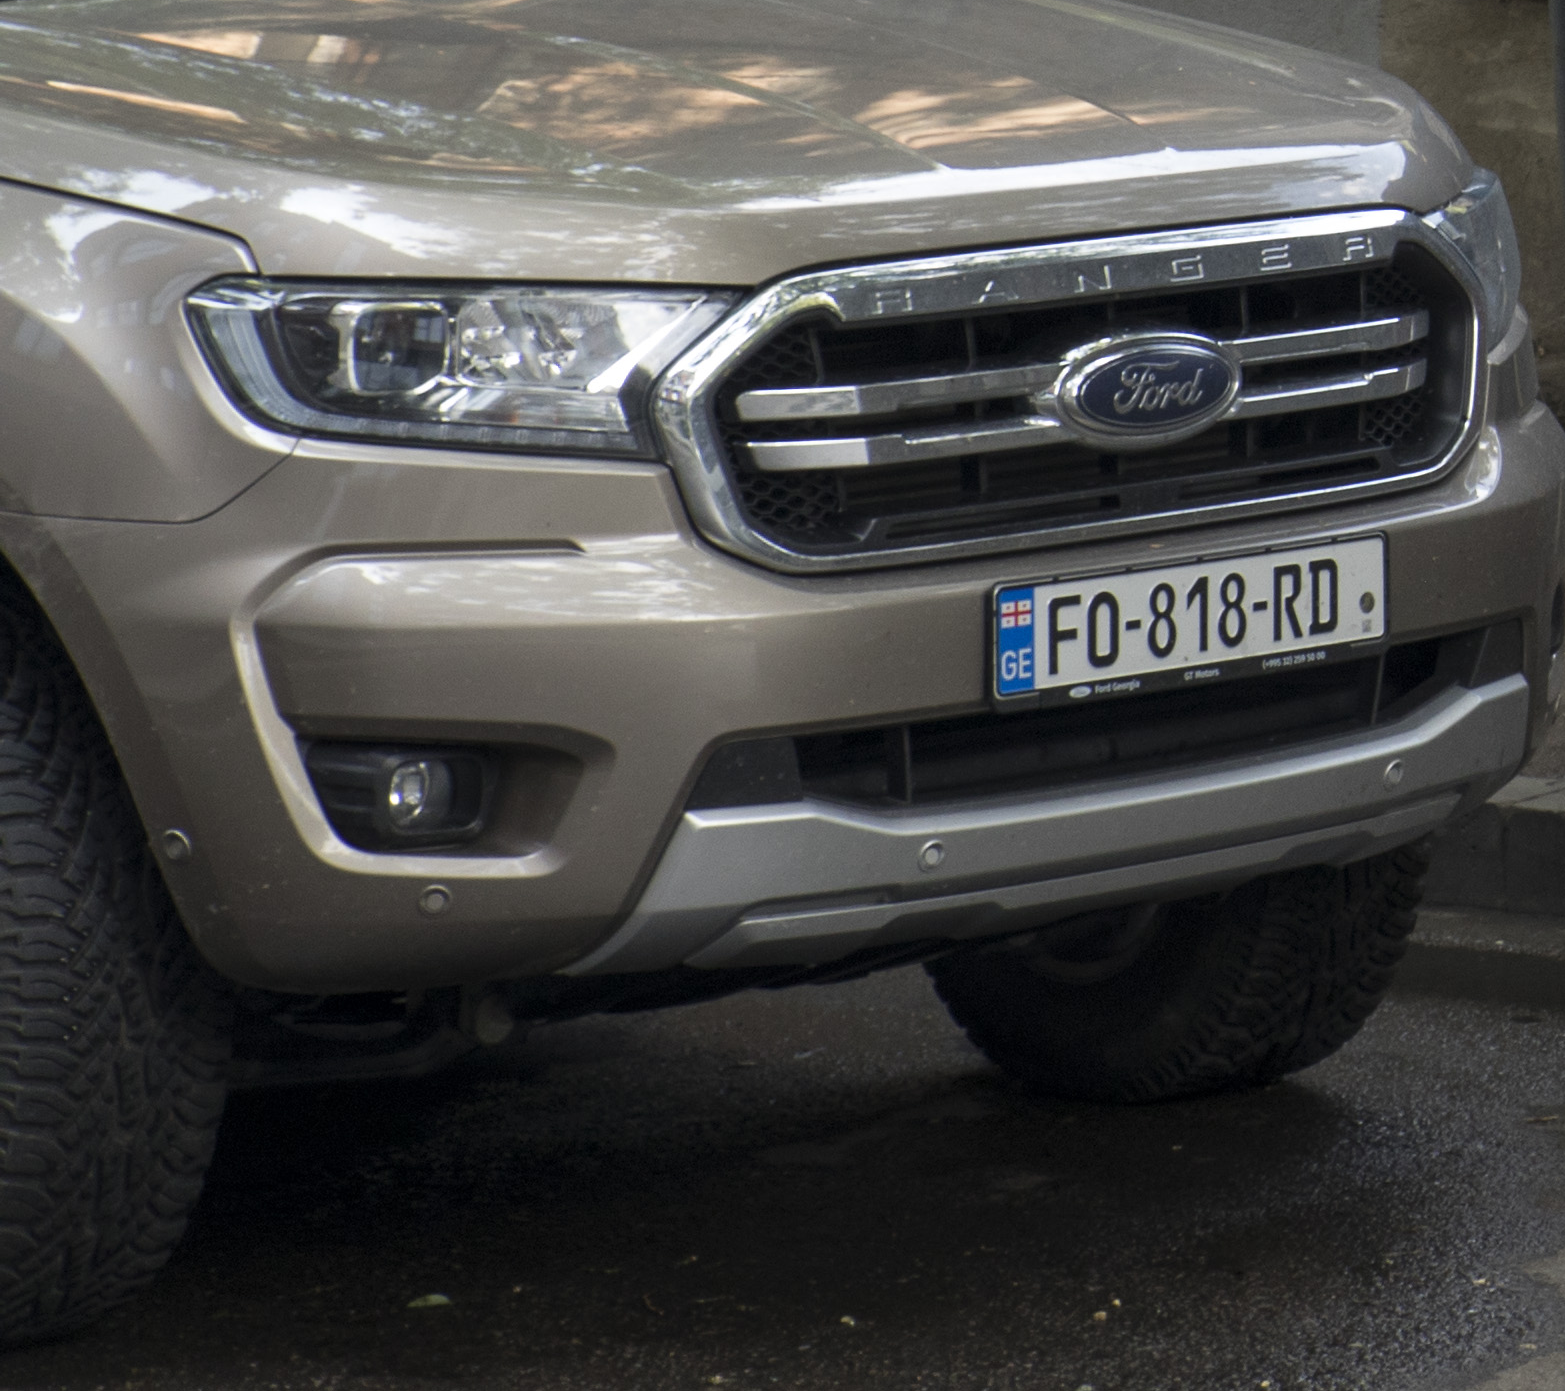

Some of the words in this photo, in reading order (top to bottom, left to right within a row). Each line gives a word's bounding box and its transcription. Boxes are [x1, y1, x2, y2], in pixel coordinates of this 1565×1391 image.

[873, 236, 1376, 315] RANGER
[1113, 358, 1205, 416] Ford
[1047, 557, 1339, 677] FO-818-RD
[1000, 647, 1033, 681] GE
[1094, 681, 1111, 694] Ford
[1112, 678, 1140, 693] Georgia
[1195, 668, 1220, 679] Motors
